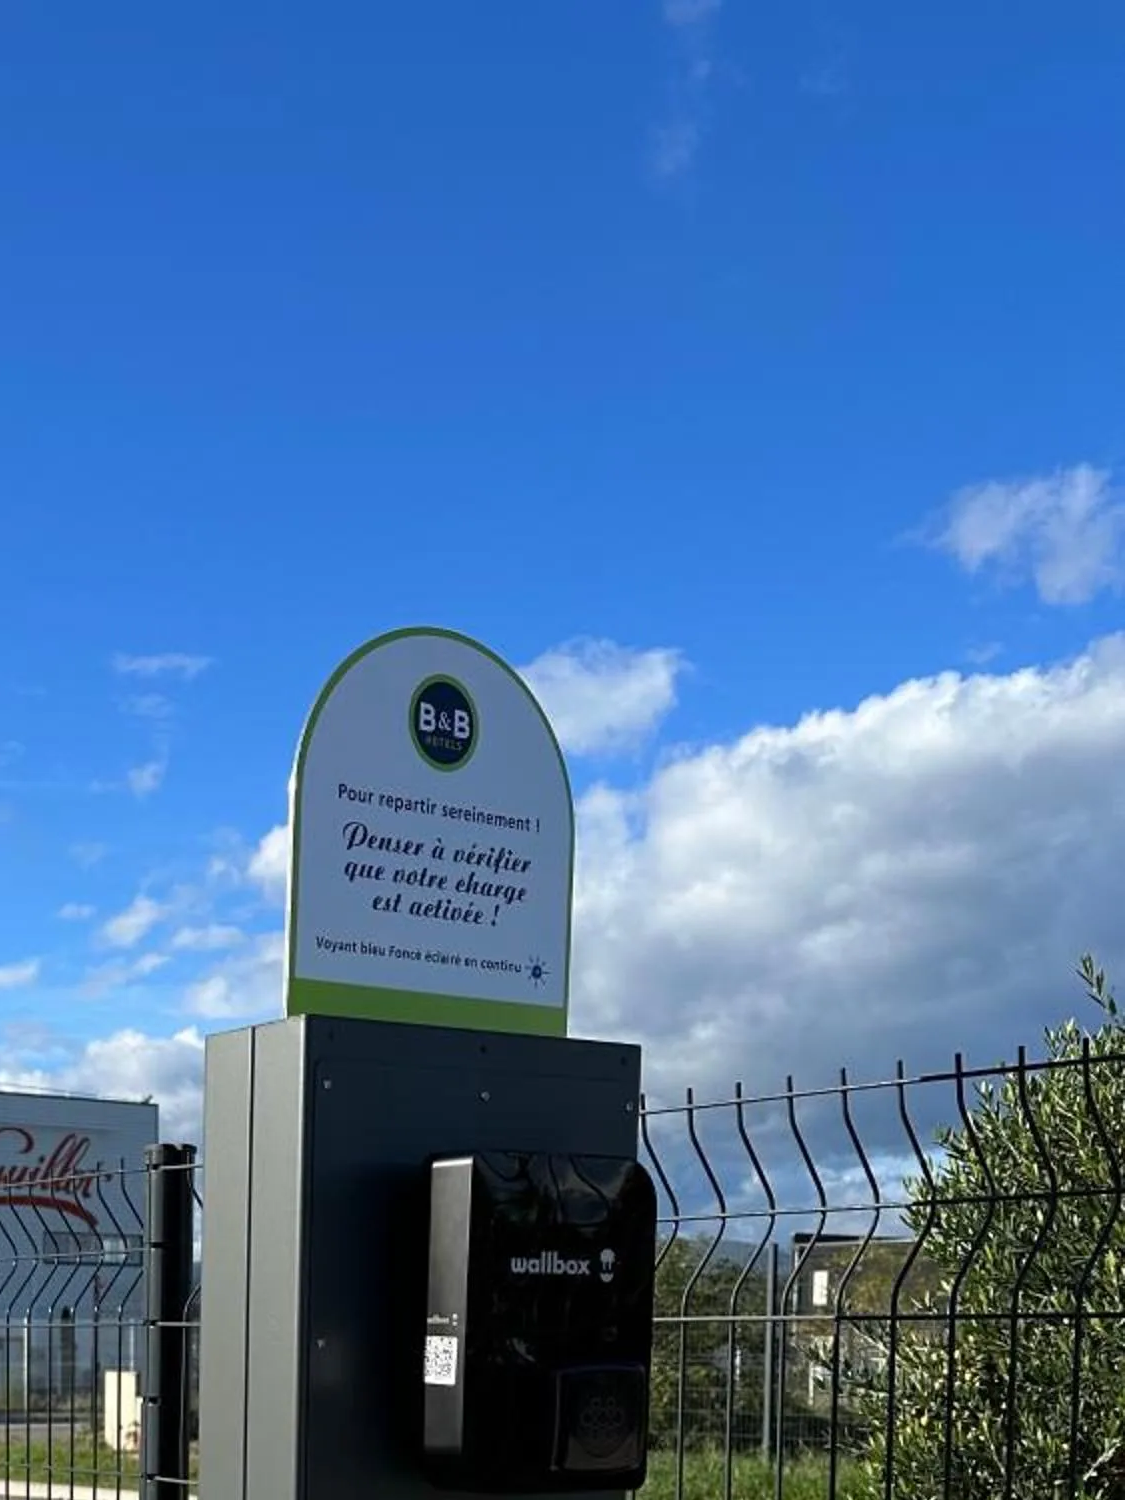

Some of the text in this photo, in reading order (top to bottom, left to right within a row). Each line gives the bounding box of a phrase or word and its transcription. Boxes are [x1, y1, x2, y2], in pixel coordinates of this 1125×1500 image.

[419, 701, 470, 739] B&B
[338, 783, 374, 805] Pour
[378, 793, 437, 815] repartir
[442, 804, 530, 832] sereinement
[342, 821, 531, 875] Penser à vérifier
[344, 861, 527, 905] que votre charge
[372, 893, 402, 914] est
[409, 899, 484, 926] activée
[315, 936, 357, 954] Voyant
[360, 942, 386, 957] bleu
[464, 956, 477, 968] en
[481, 958, 522, 974] continu
[510, 1251, 591, 1276] wallbox
